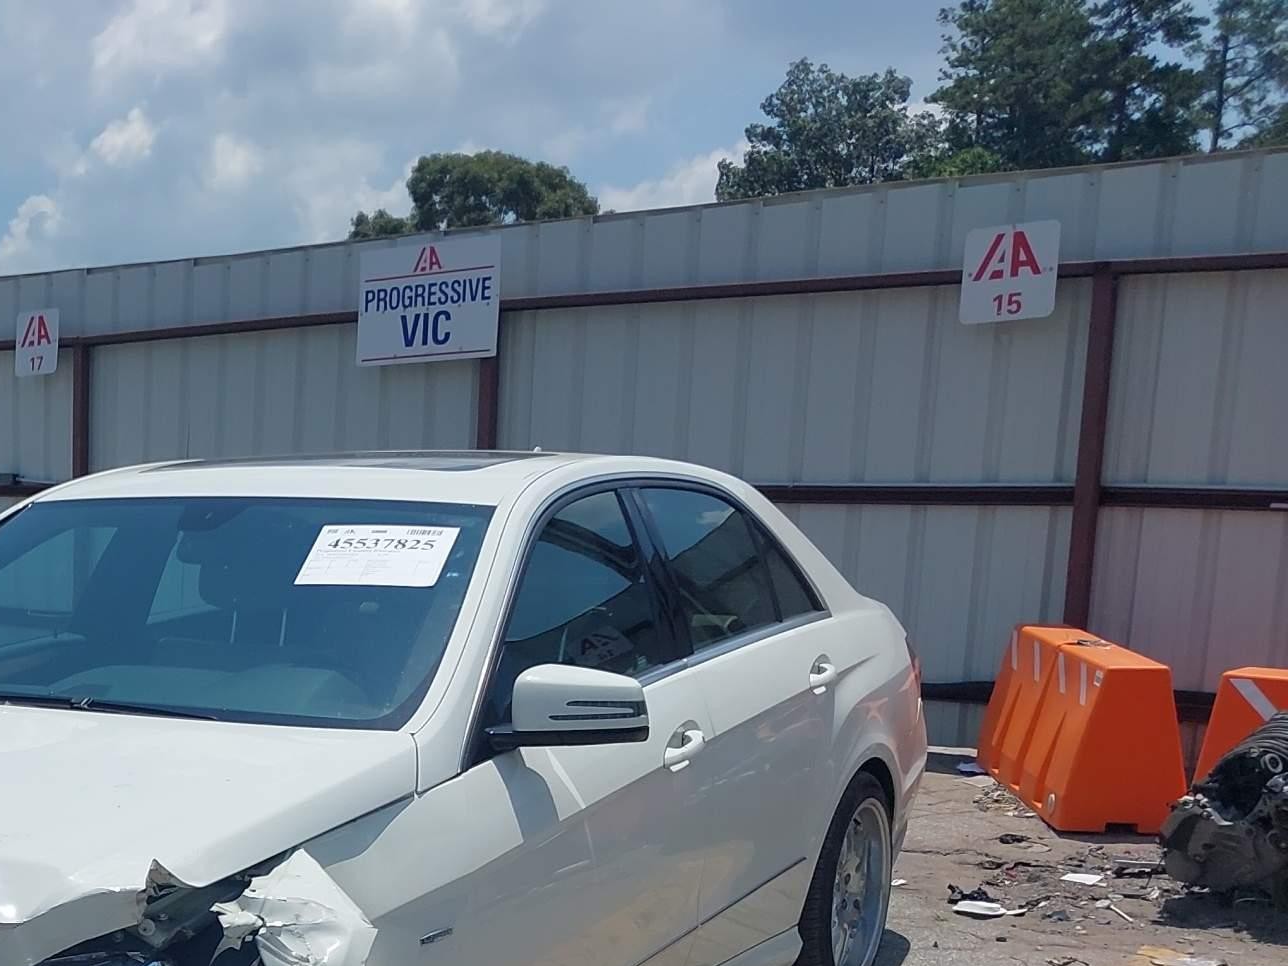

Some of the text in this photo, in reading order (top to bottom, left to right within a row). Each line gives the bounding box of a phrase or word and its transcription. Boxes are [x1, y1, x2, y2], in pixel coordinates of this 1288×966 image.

[364, 276, 493, 313] PROGRESSIVE
[993, 292, 1022, 316] 15
[400, 310, 452, 348] VIC
[30, 356, 44, 371] 17
[327, 538, 437, 551] 45537825
